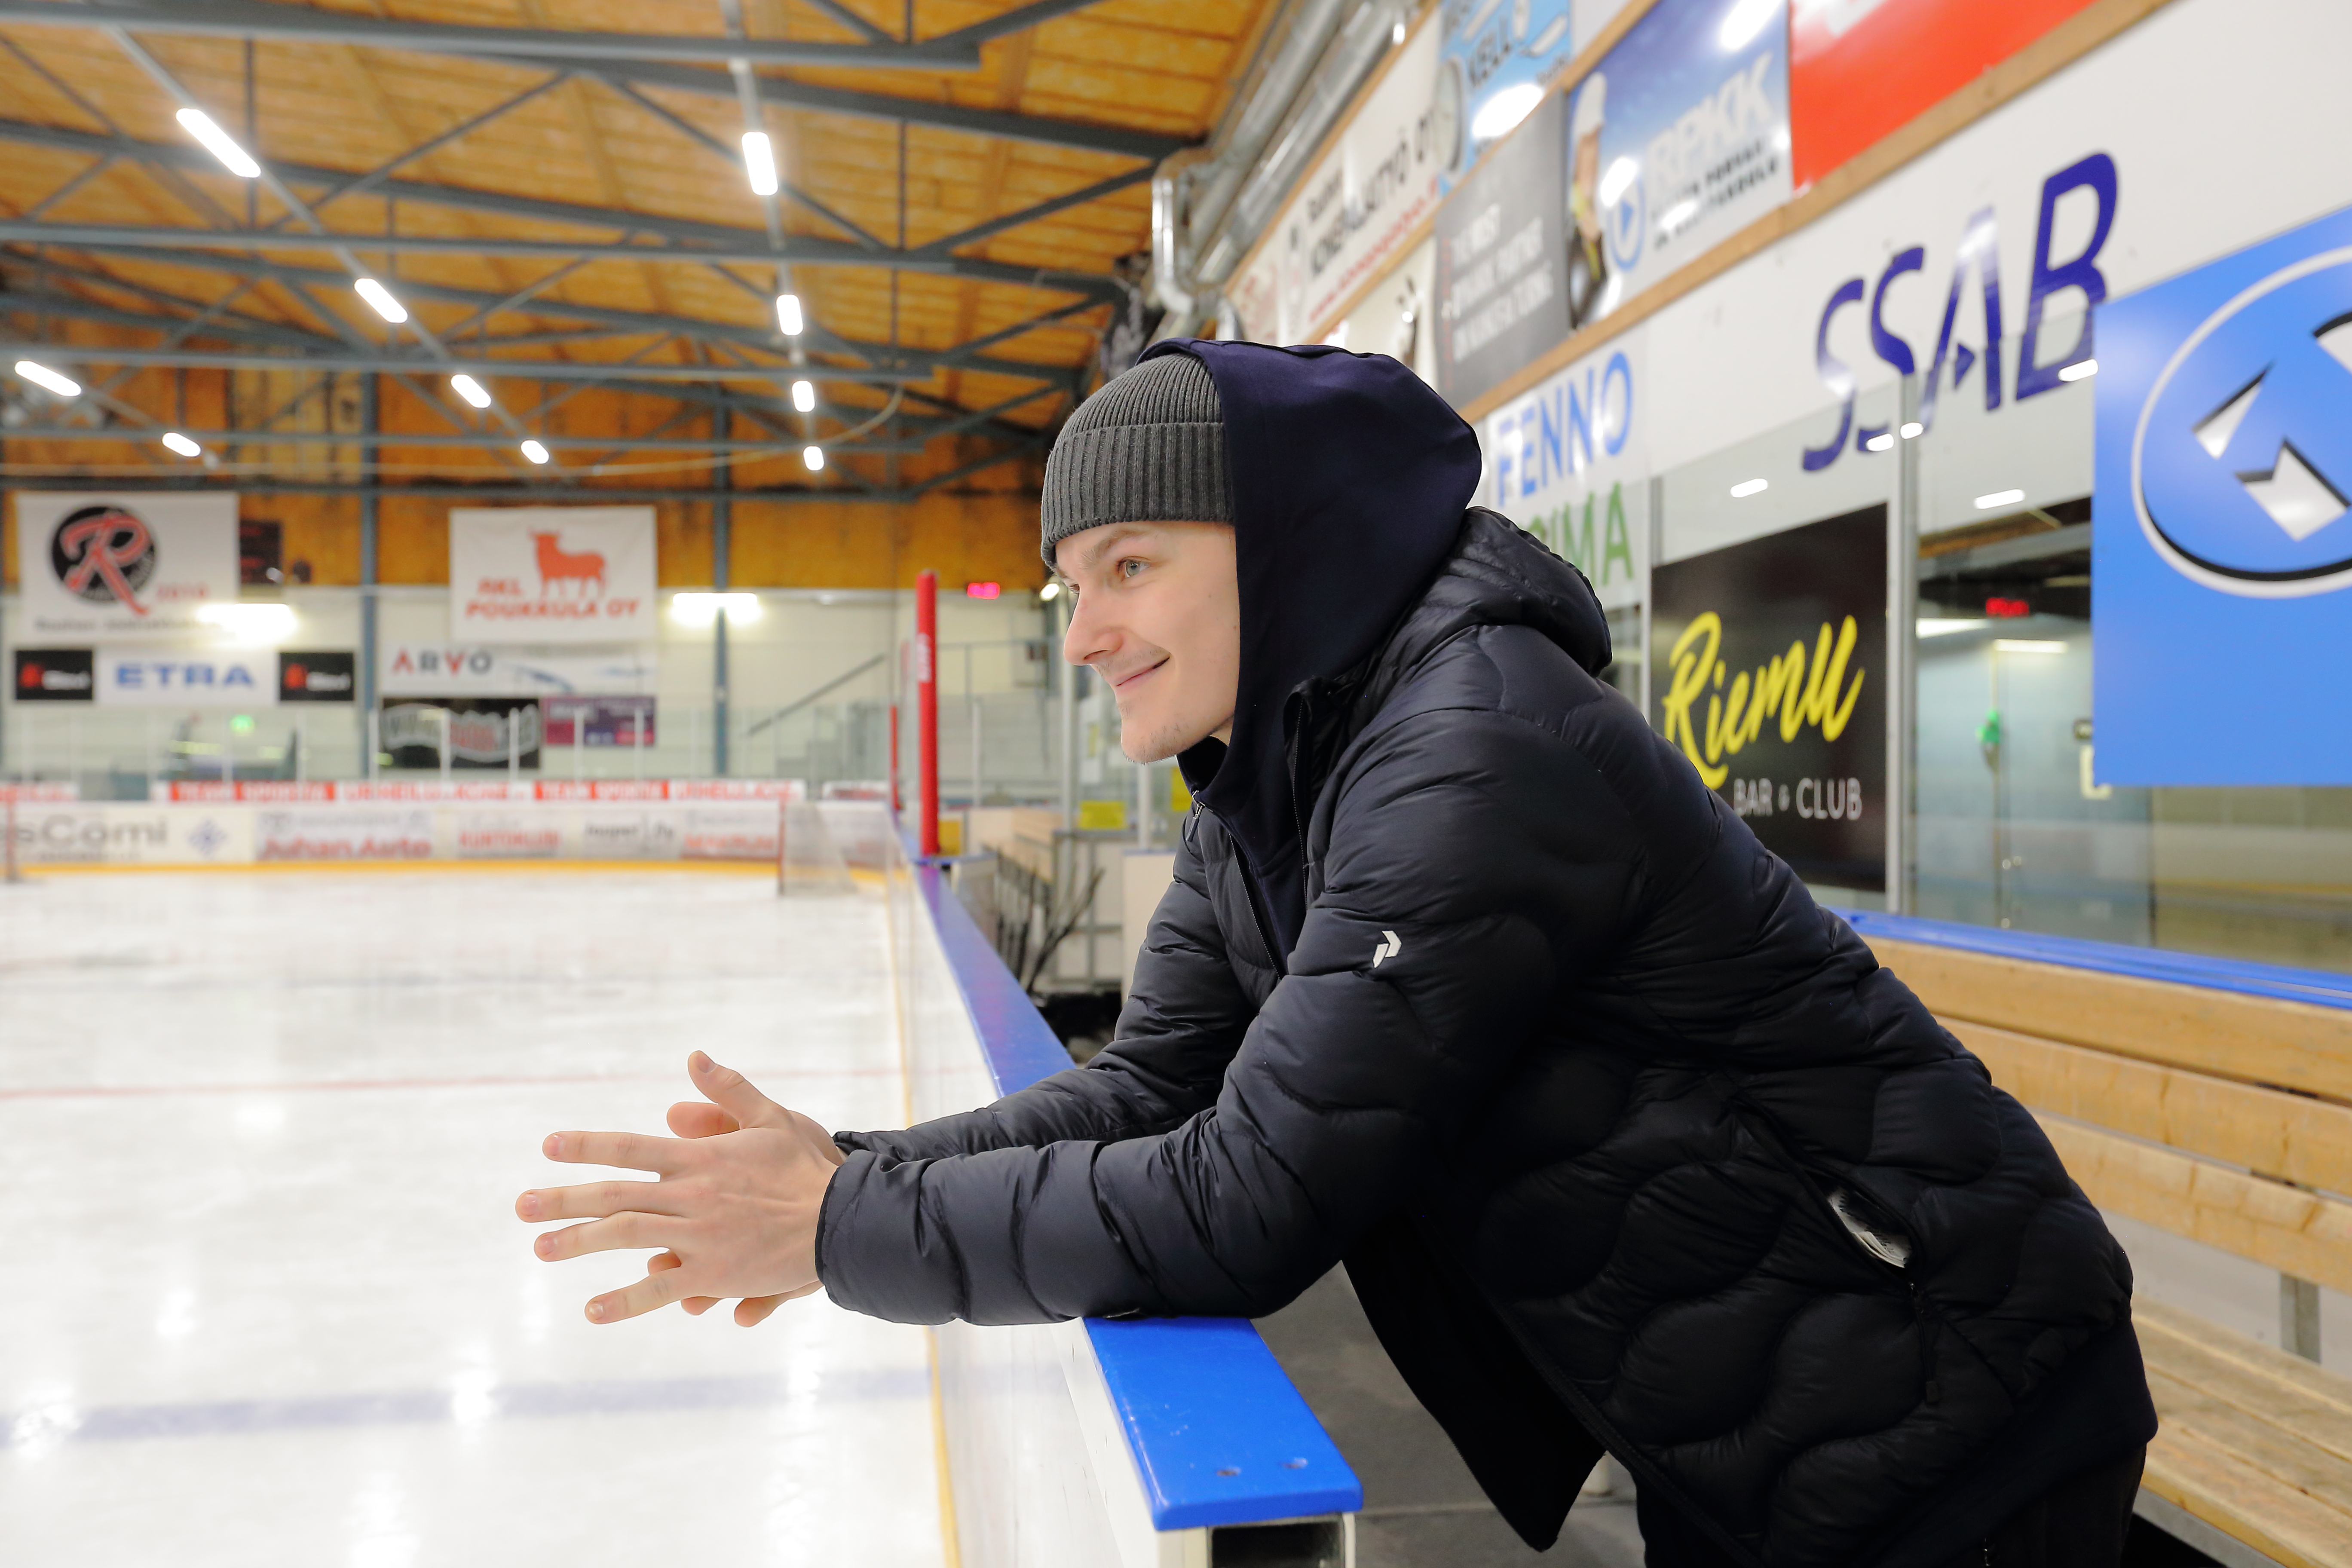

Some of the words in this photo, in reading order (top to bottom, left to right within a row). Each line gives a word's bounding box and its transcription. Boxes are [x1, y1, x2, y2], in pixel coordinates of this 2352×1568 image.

[1645, 52, 1774, 190] RPKK
[1801, 151, 2118, 473] SSAB
[1497, 351, 1633, 508] FENNO
[606, 597, 640, 618] OY
[115, 664, 254, 688] ETRA
[392, 649, 493, 676] ARVO
[1662, 611, 1865, 790] Riemu
[1733, 778, 1773, 817] BAR
[1796, 777, 1862, 821] CLUB
